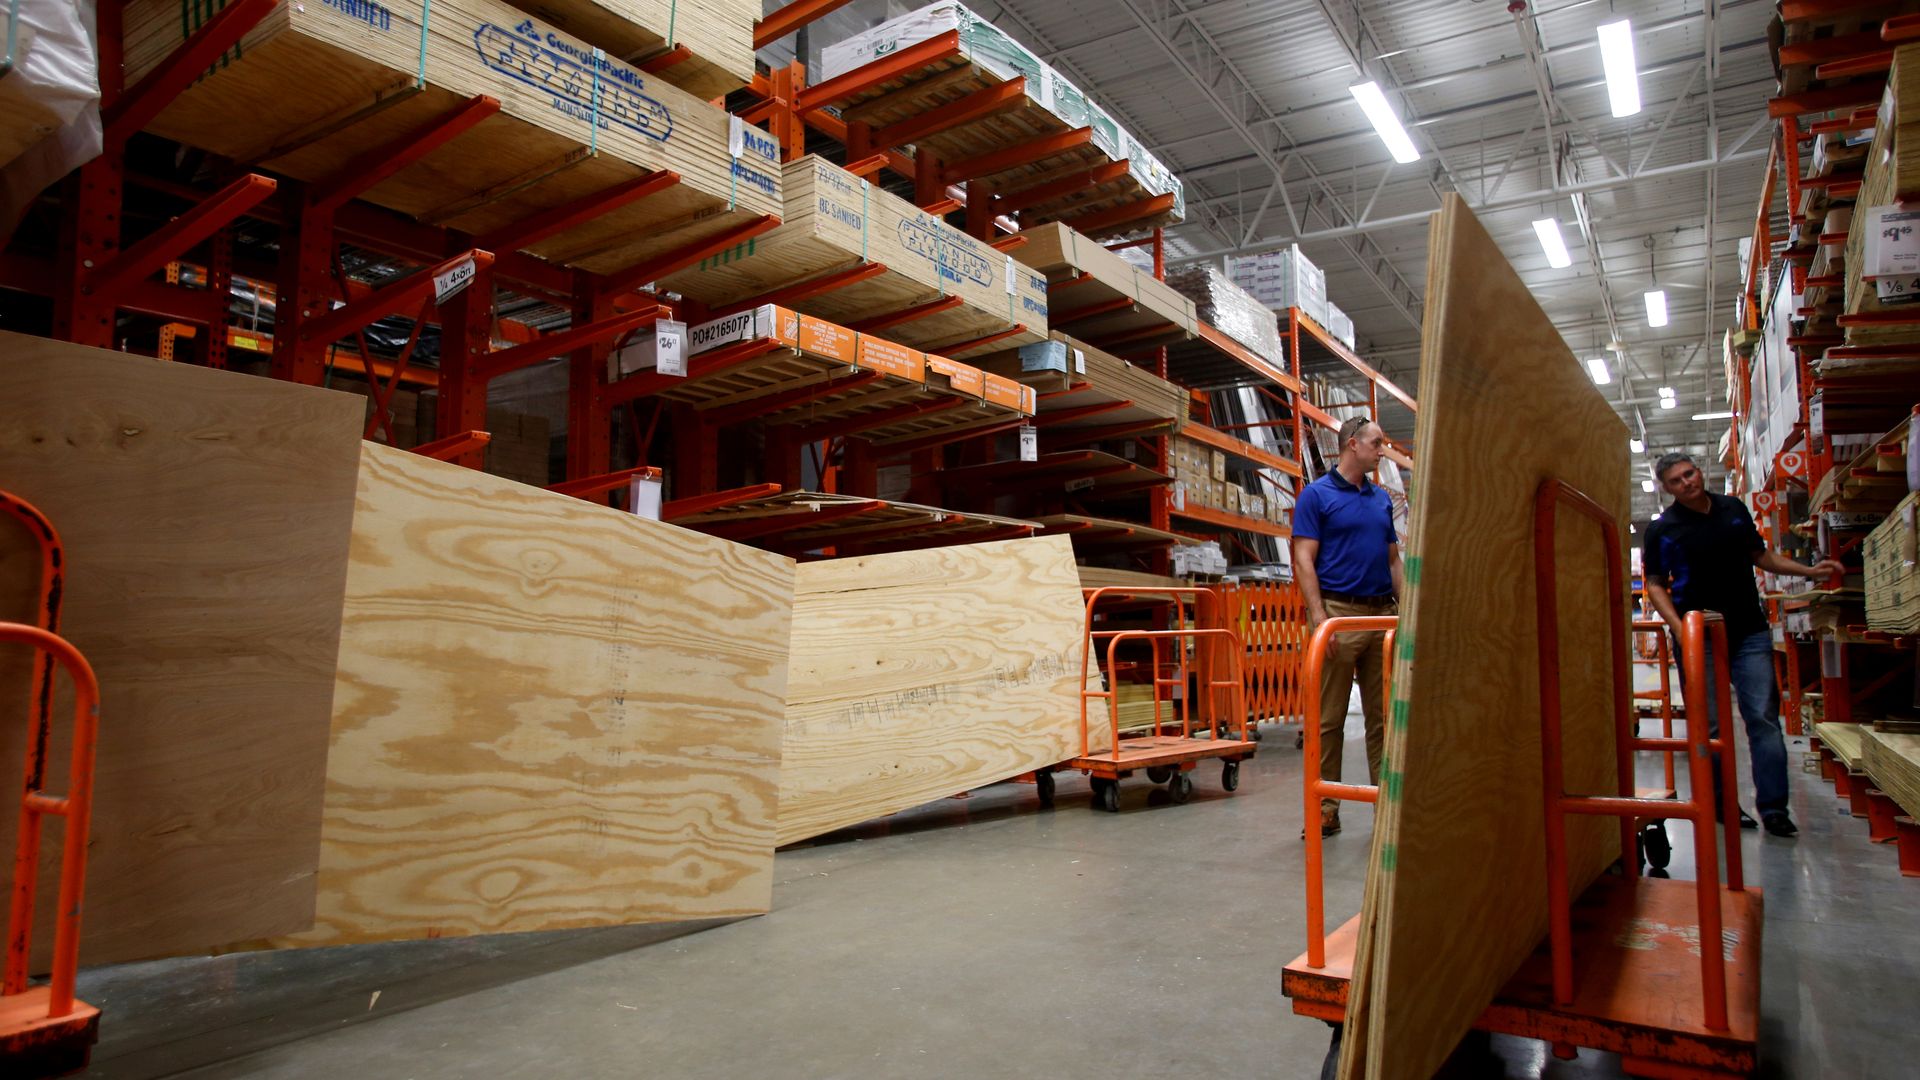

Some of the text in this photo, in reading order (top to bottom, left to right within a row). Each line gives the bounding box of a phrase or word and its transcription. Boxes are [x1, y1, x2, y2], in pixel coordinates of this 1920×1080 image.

[322, 0, 390, 31] ANDED
[831, 204, 862, 230] SANDED
[903, 223, 988, 273] PLYTANIUM
[908, 236, 981, 279] PLYWOOD
[692, 314, 750, 346] PO#21650TP
